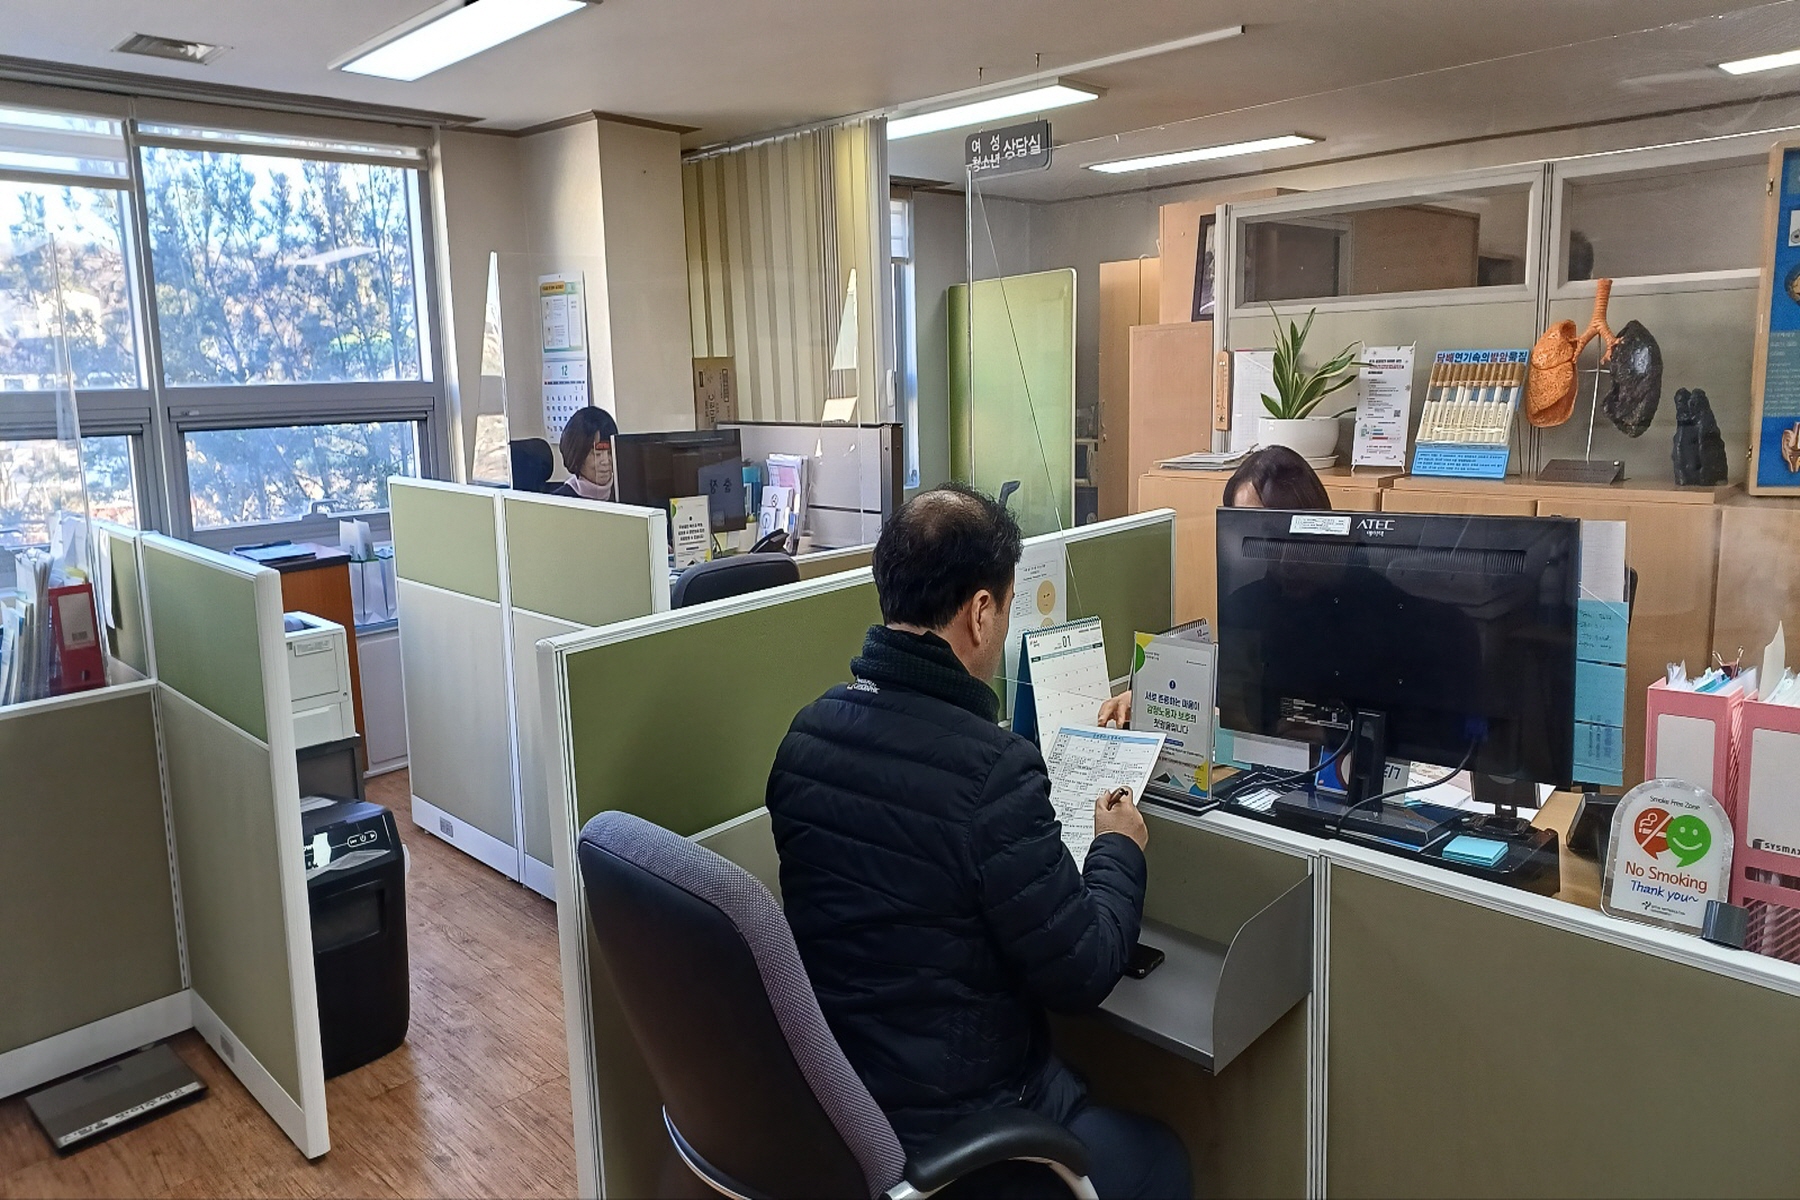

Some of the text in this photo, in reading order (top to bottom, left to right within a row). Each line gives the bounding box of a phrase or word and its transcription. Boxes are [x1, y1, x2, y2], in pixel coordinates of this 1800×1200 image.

[1003, 133, 1042, 160] 상담실
[971, 152, 1000, 173] 청소년
[561, 364, 568, 376] 12
[1356, 519, 1396, 531] ATEC
[1062, 635, 1071, 648] 01
[1649, 795, 1701, 810] Smoke Free Zone
[1625, 861, 1708, 894] No Smoking
[1631, 879, 1666, 898] Thank
